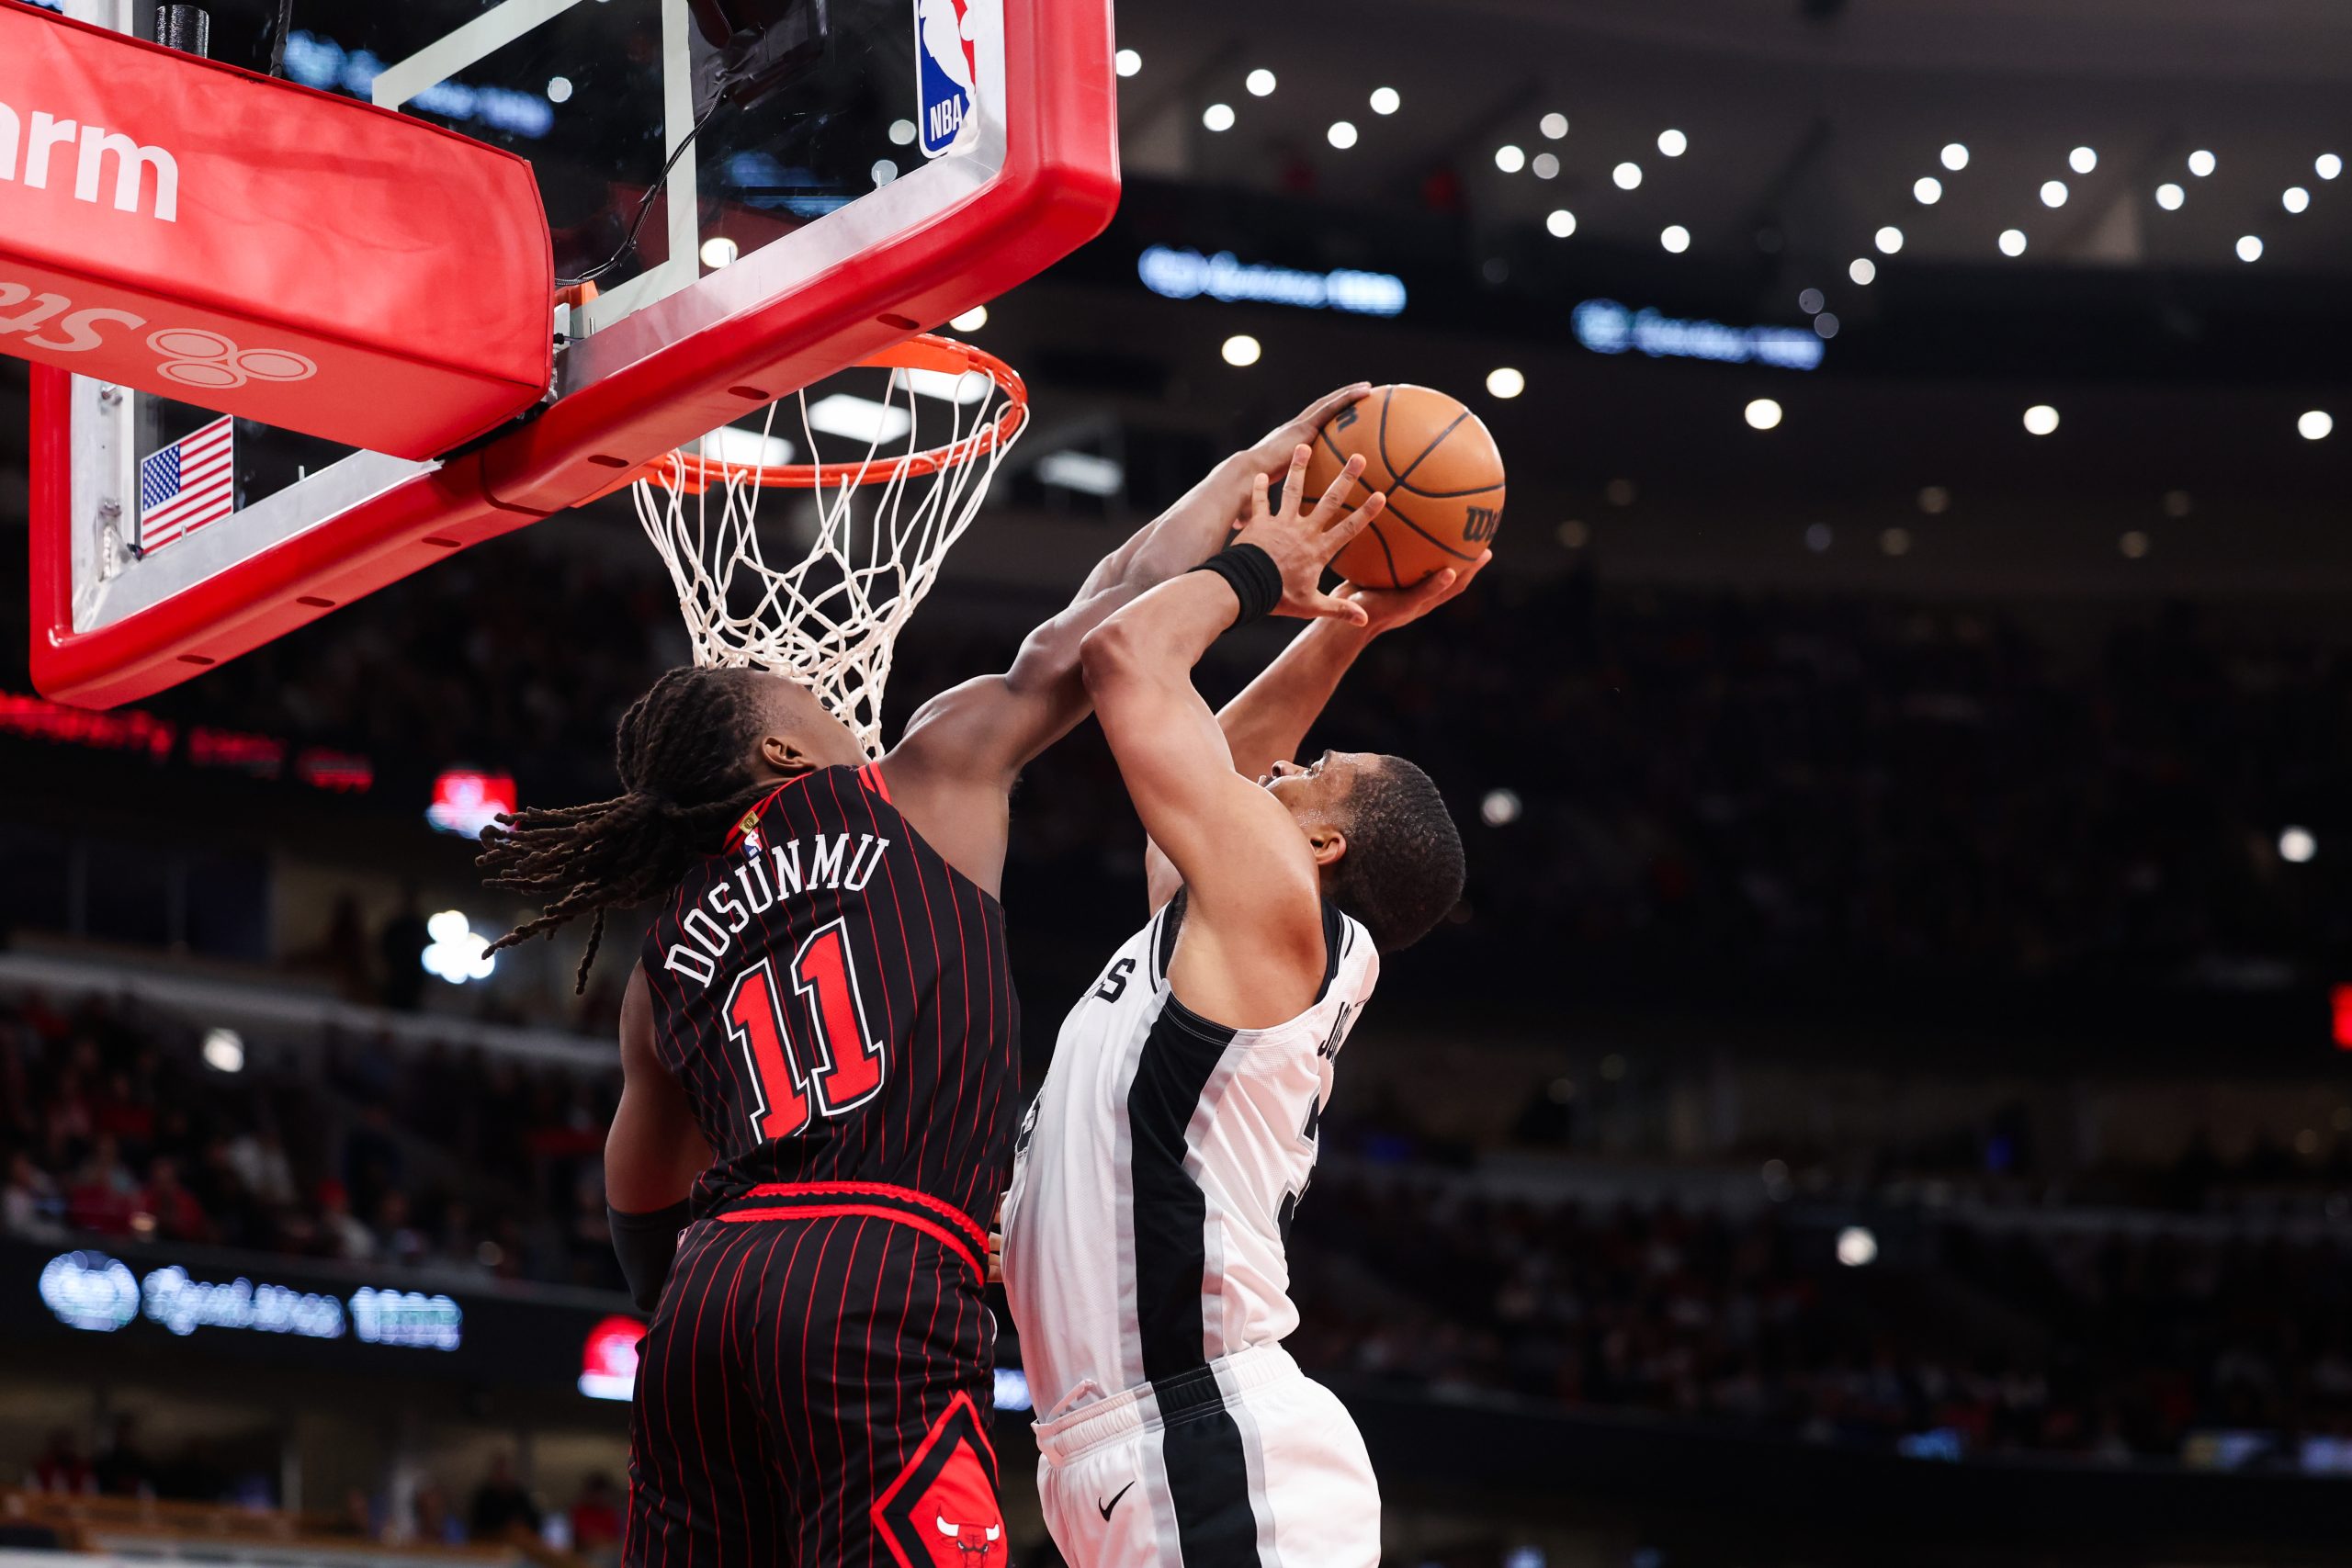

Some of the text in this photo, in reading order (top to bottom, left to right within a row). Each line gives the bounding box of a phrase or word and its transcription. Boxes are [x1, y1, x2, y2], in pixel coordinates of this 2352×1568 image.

[930, 94, 963, 142] NBA
[664, 833, 890, 988] DOSUNMU
[722, 916, 886, 1145] 11
